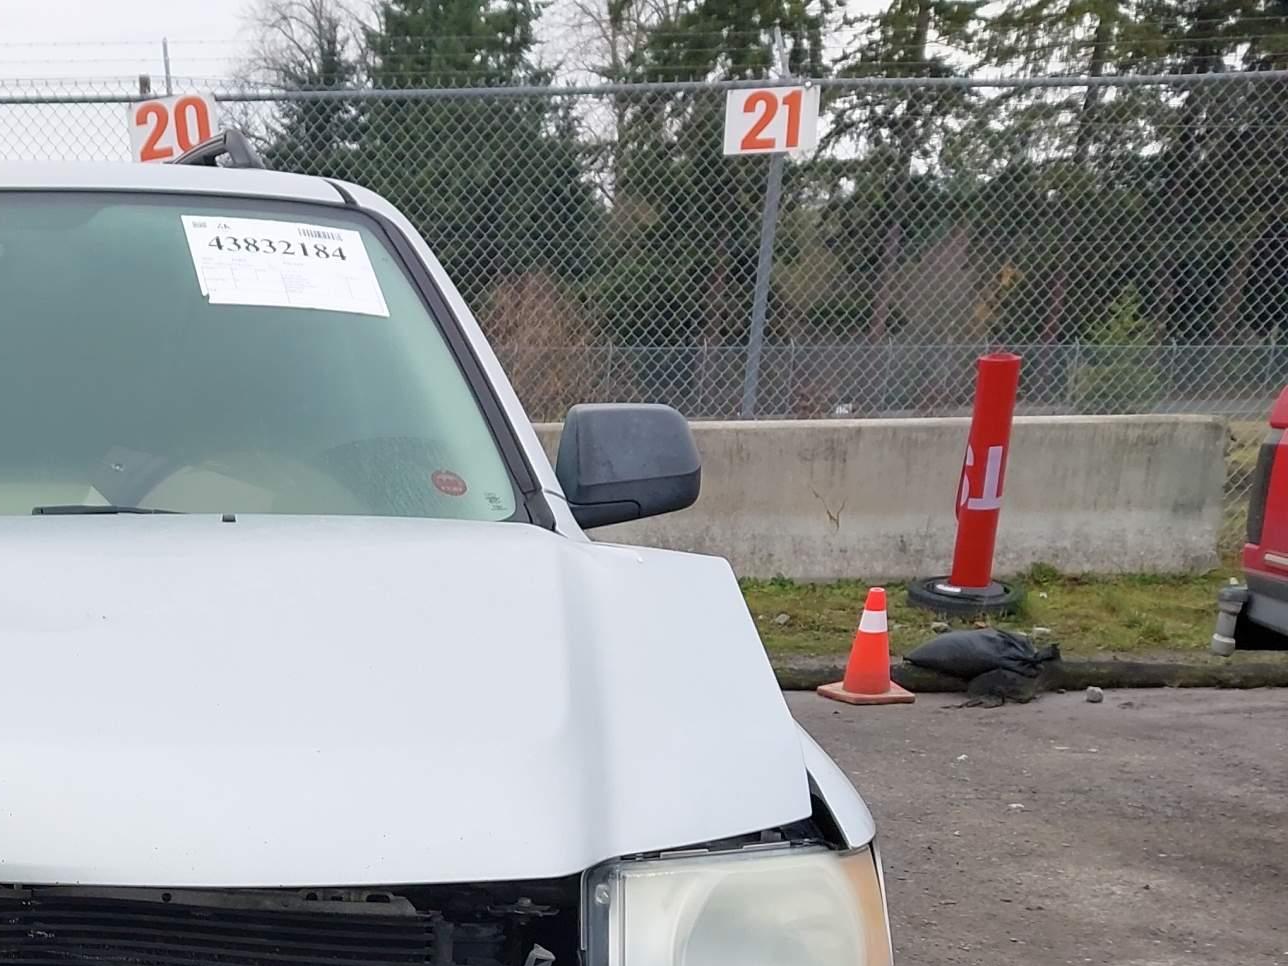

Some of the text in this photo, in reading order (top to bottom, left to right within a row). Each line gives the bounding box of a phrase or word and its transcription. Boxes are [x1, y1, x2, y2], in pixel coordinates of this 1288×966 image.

[135, 95, 211, 162] 20
[739, 89, 802, 151] 21
[208, 235, 347, 261] 43832184
